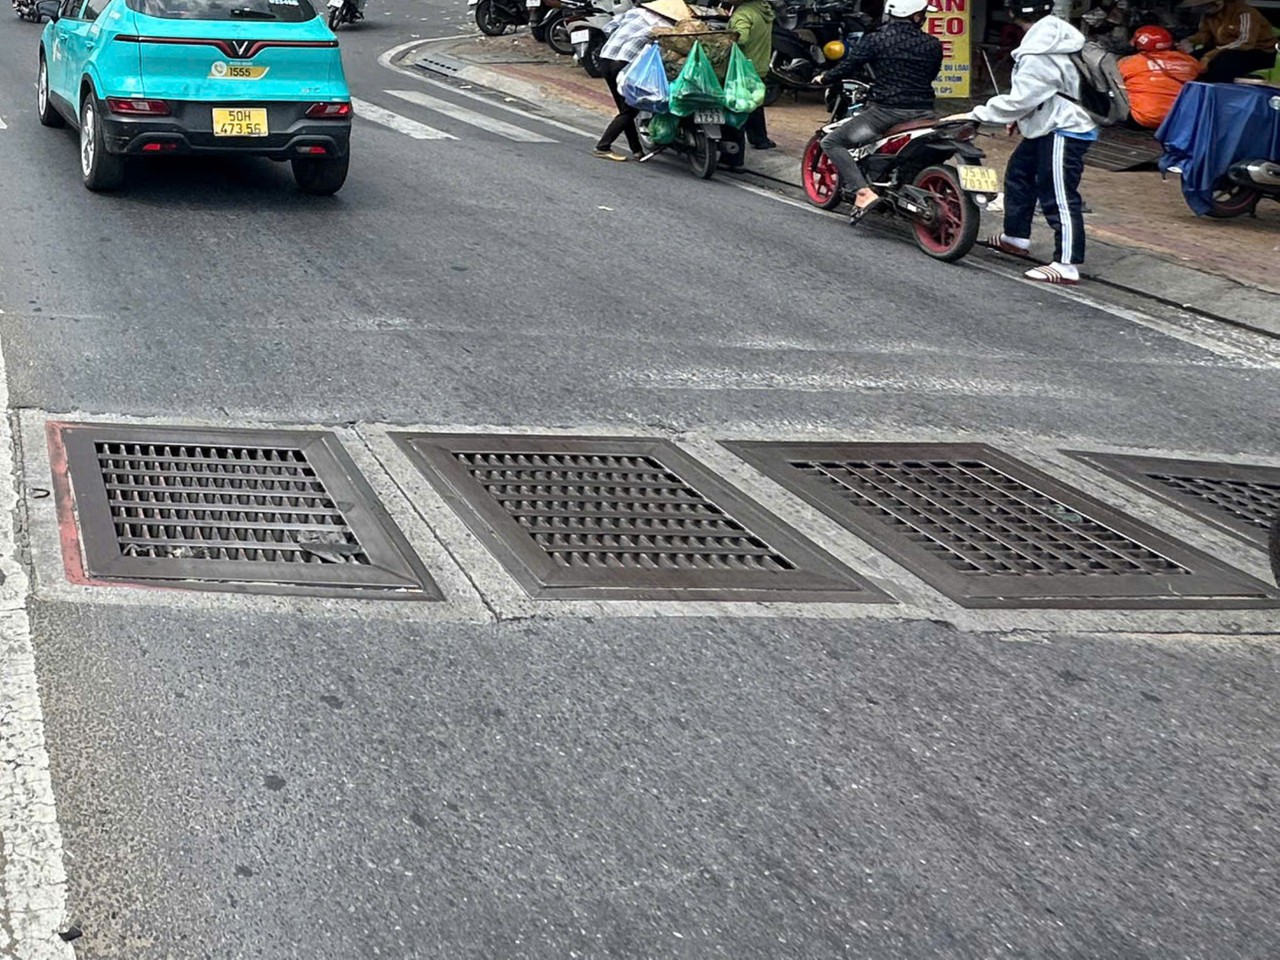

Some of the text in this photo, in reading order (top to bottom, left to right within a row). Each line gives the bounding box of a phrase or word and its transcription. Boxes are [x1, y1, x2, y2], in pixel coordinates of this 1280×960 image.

[927, 17, 964, 35] EO
[229, 67, 251, 77] 1555
[228, 110, 251, 122] 50H
[220, 122, 261, 134] 473.56
